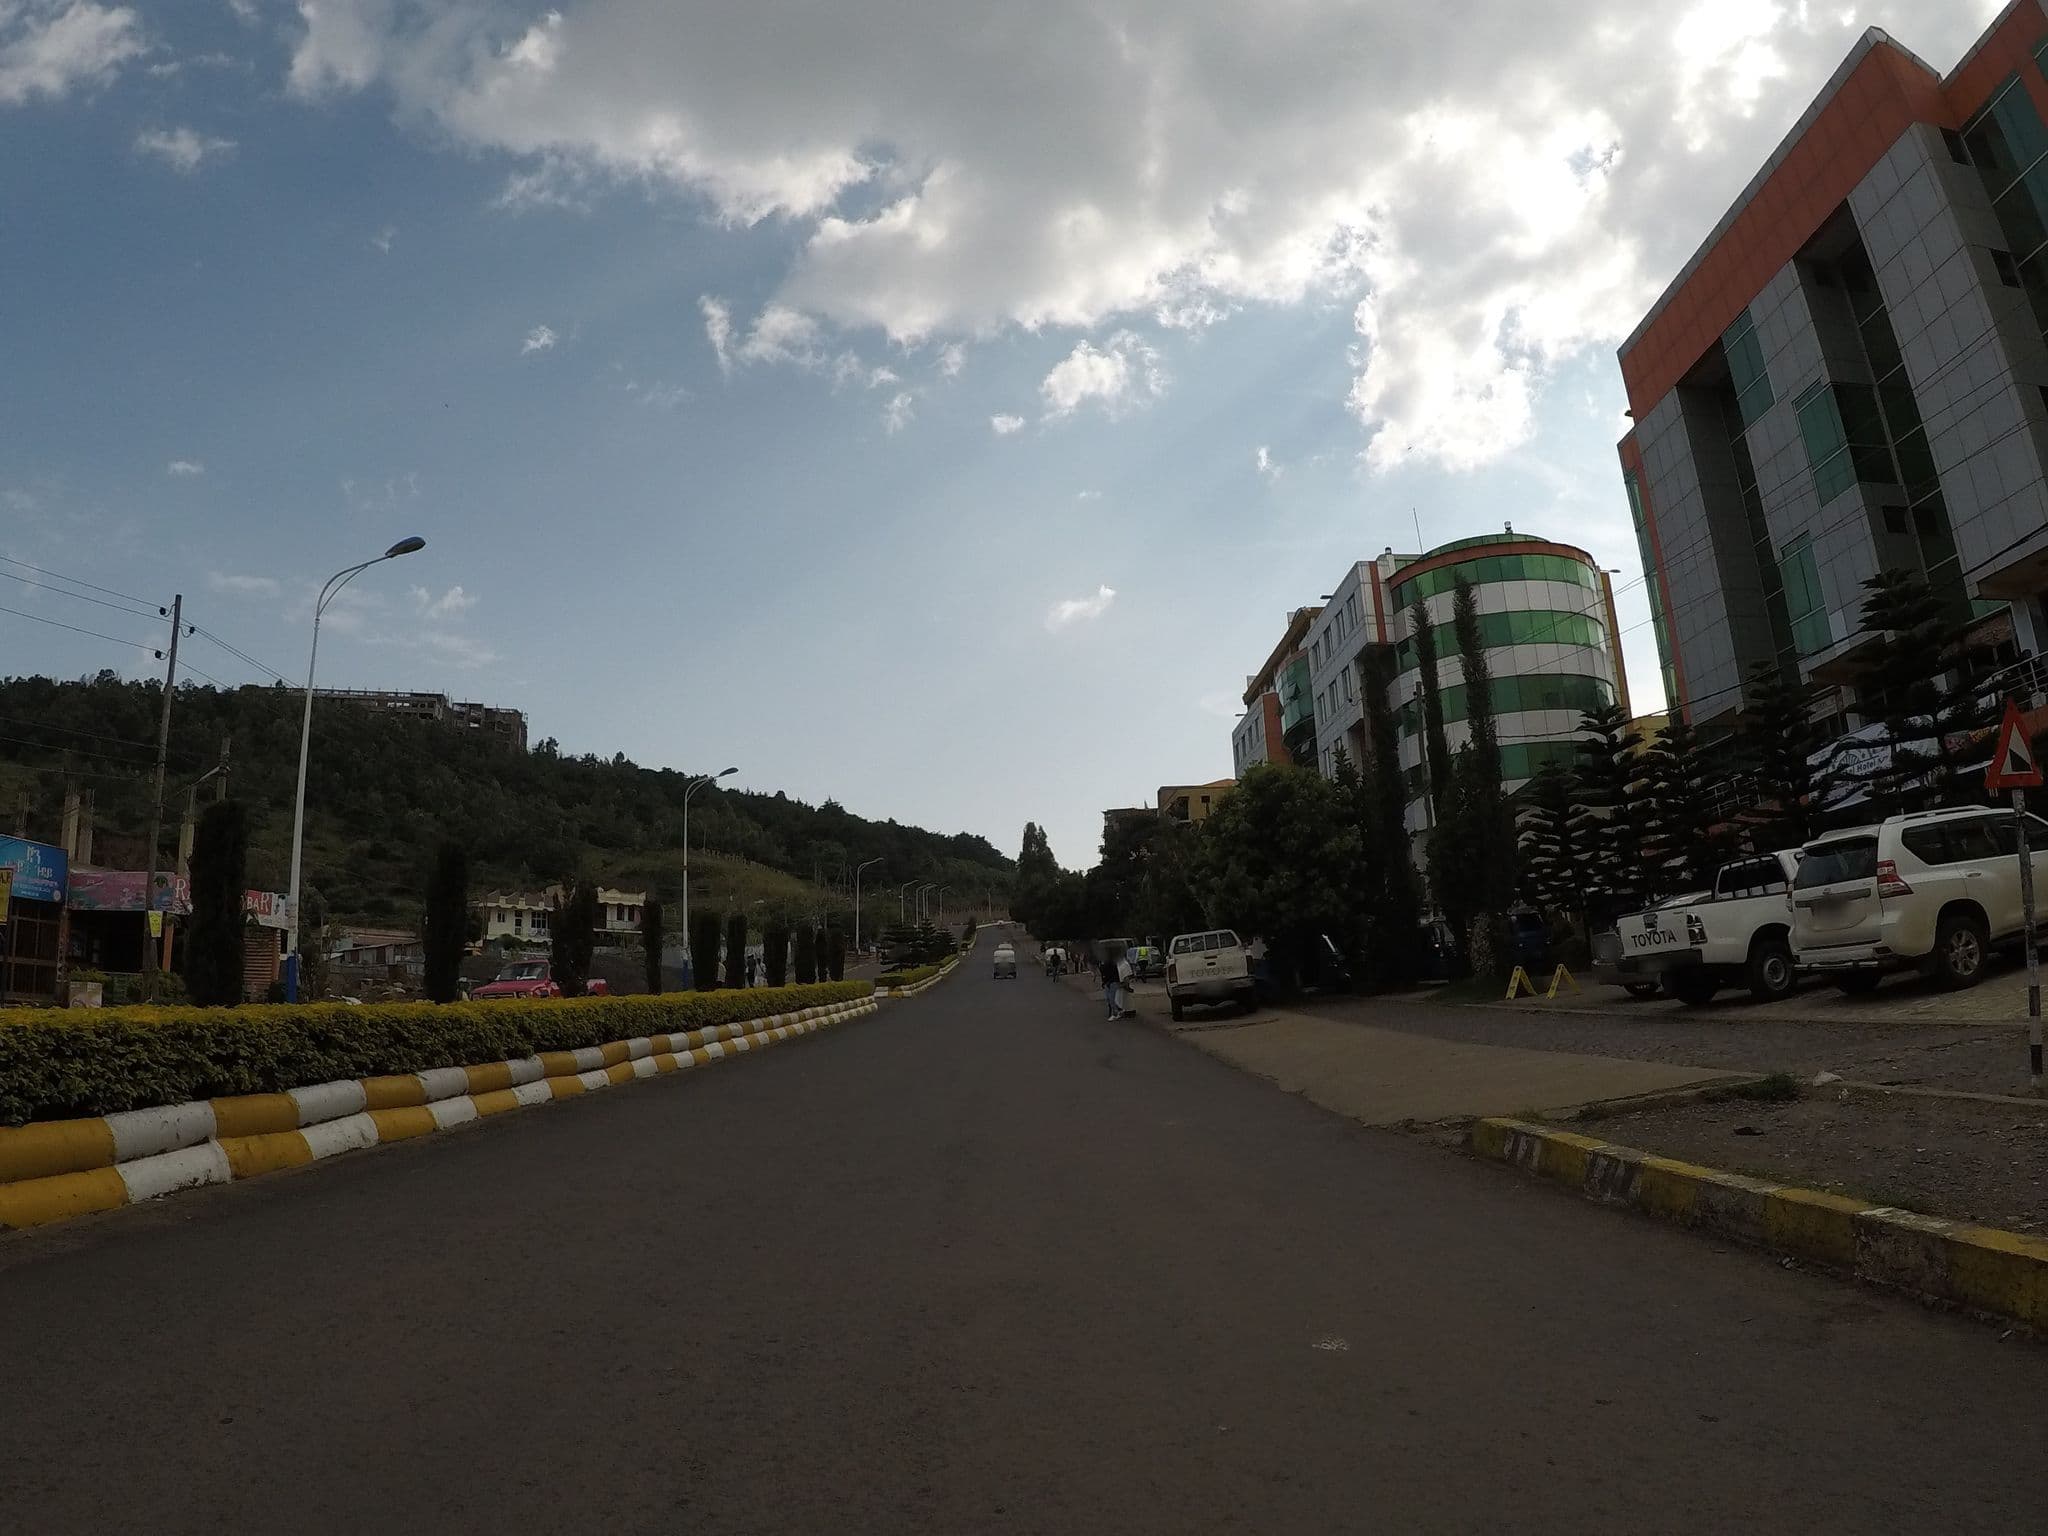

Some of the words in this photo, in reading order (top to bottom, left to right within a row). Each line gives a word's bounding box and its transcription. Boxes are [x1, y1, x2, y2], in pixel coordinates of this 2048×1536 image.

[247, 892, 270, 913] BAR
[1631, 930, 1678, 948] TOYOTA
[1191, 965, 1234, 978] TOYOTA
